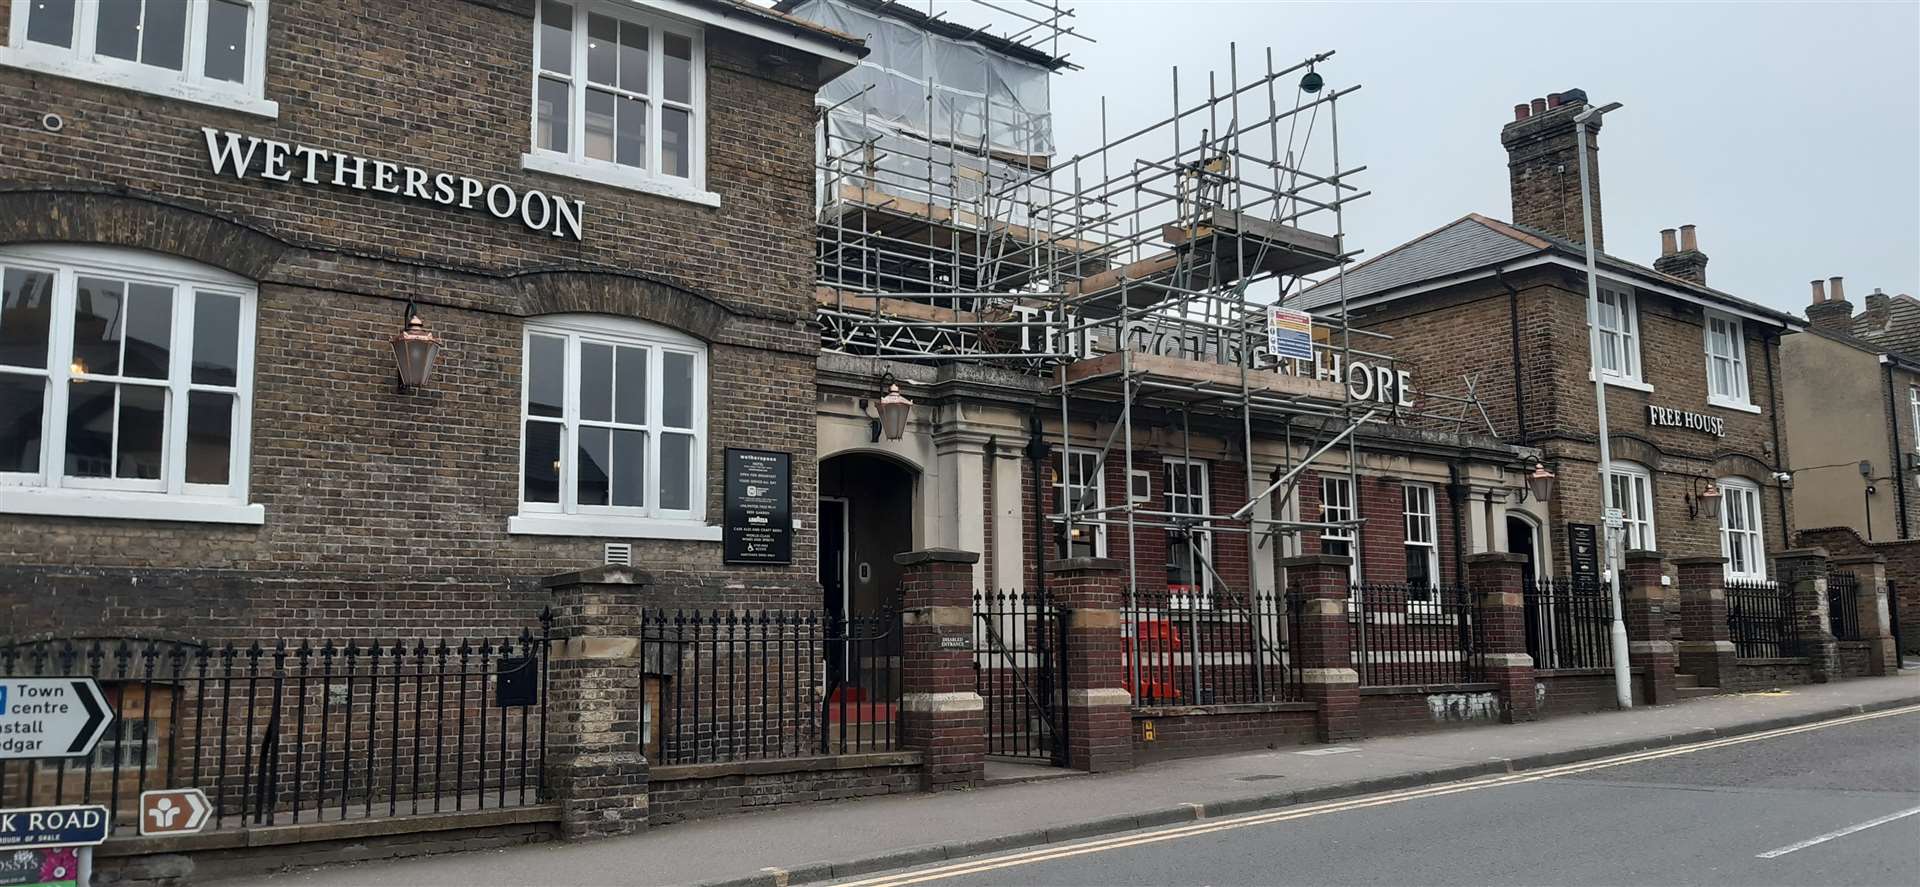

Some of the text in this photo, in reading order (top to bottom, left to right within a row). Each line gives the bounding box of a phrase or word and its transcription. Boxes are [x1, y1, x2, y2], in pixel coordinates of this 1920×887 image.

[202, 127, 585, 240] WETHERSPOON
[1012, 304, 1106, 360] THE
[1649, 405, 1725, 438] FREE HOUSE
[17, 684, 64, 697] Town
[12, 701, 69, 714] centre
[0, 720, 43, 733] stall
[0, 738, 43, 753] dgar
[29, 810, 100, 831] ROAD
